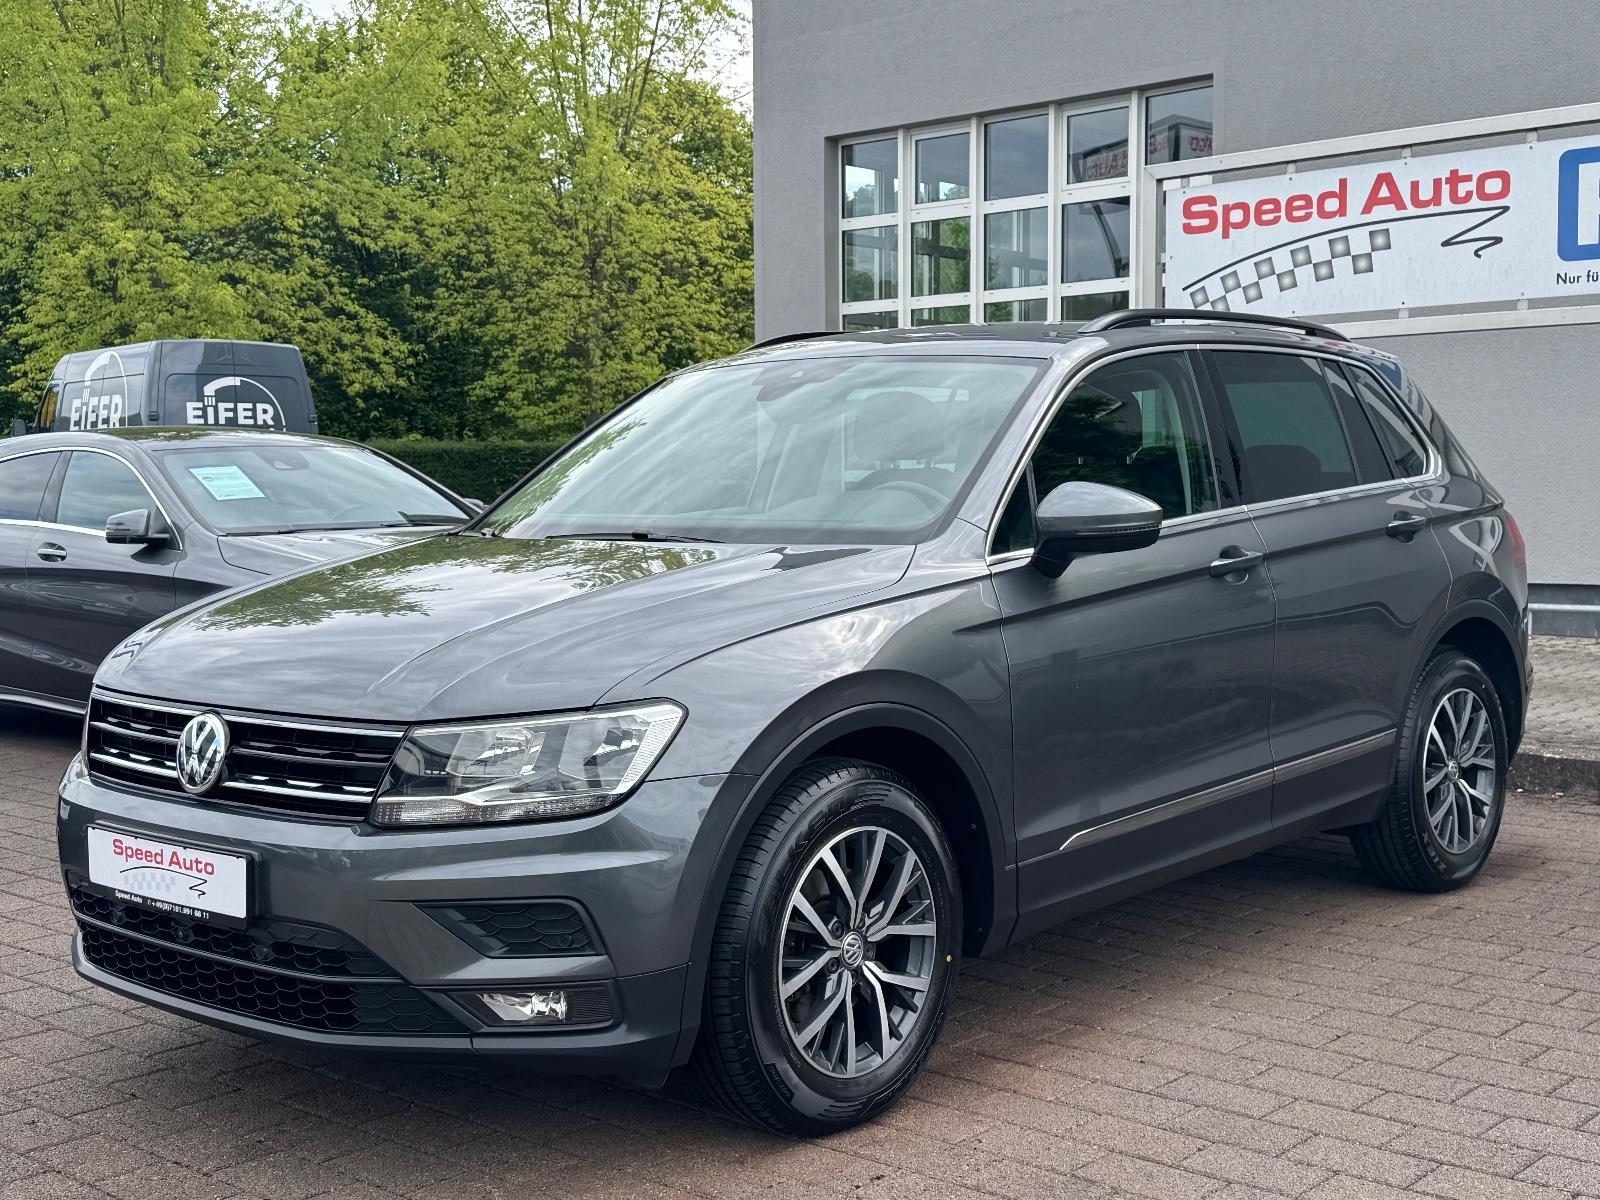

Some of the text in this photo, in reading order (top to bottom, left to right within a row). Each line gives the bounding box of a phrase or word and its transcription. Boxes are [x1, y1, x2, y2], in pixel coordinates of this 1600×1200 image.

[1182, 177, 1348, 239] Speed
[1360, 168, 1512, 216] Auto
[1556, 272, 1582, 285] Nur
[112, 838, 215, 876] Speed Auto
[115, 889, 131, 900] Speed
[131, 895, 143, 904] Auto
